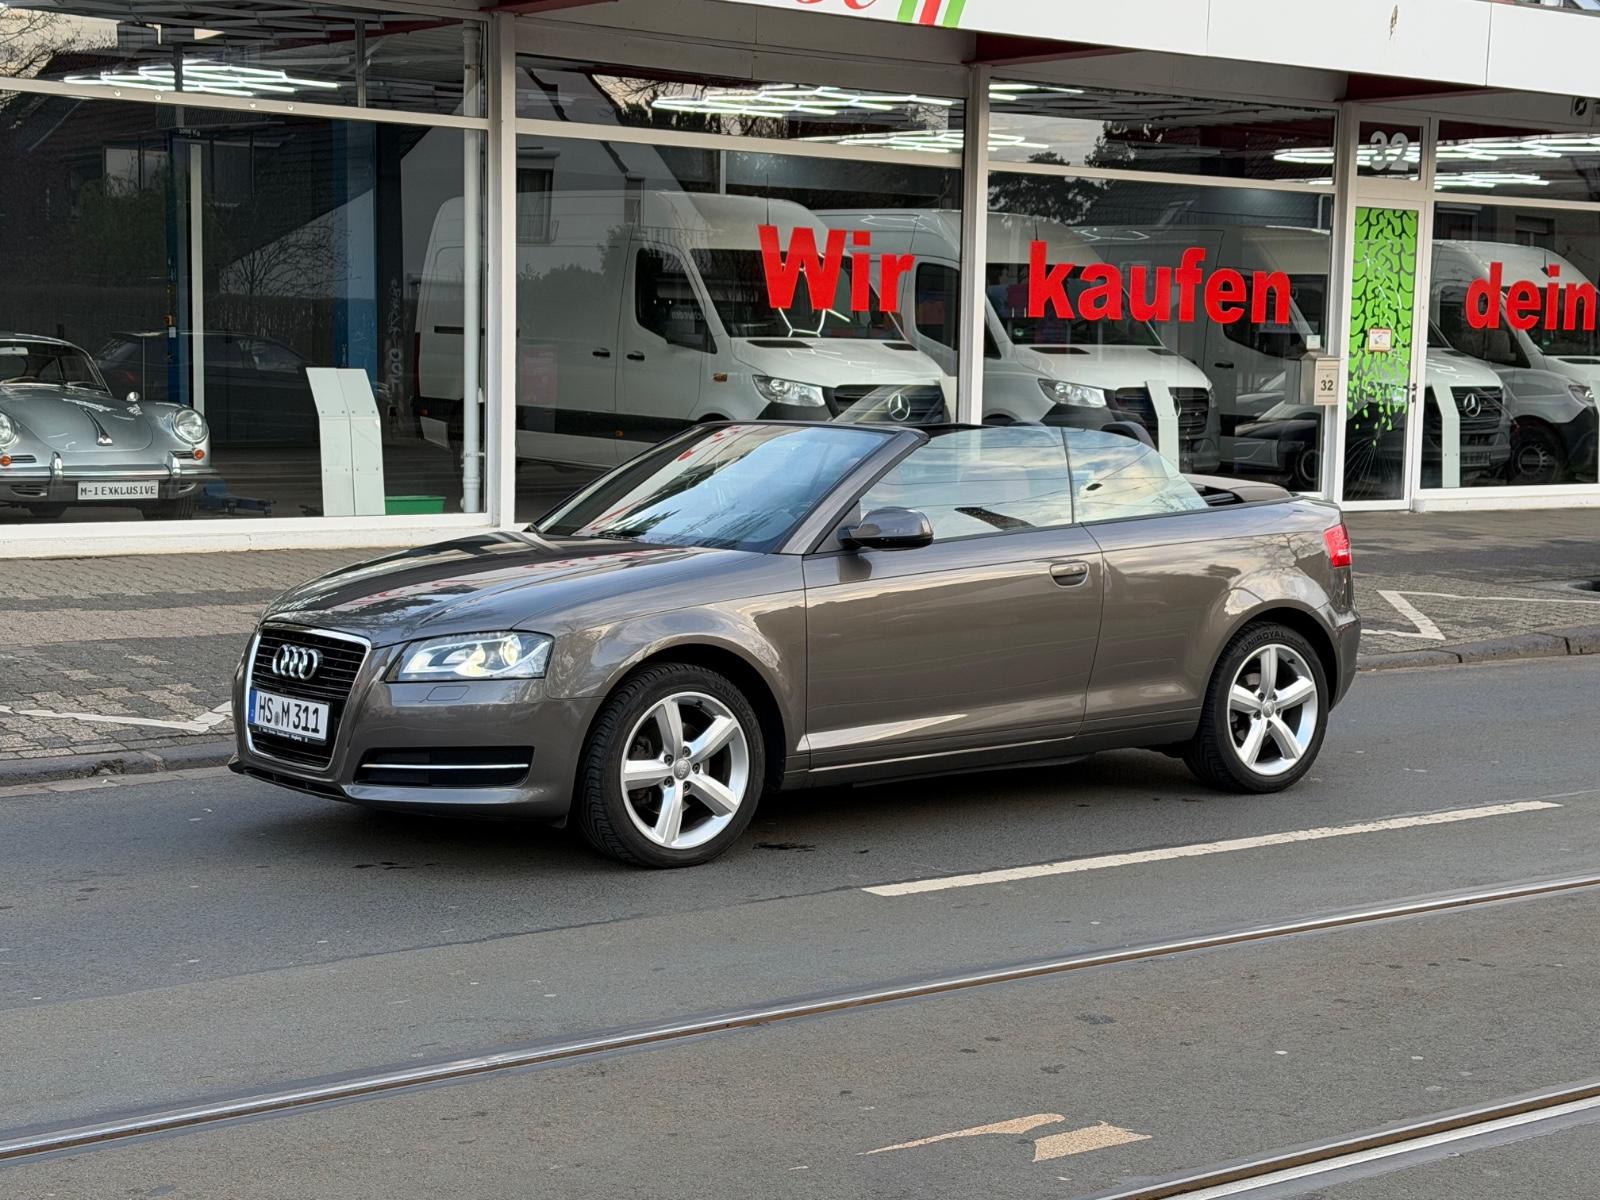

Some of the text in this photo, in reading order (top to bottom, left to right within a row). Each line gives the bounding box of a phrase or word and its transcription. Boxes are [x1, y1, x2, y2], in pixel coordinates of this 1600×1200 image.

[1370, 130, 1409, 171] 32
[758, 225, 1597, 330] Wir kaufen dein
[1320, 379, 1334, 391] 32
[258, 695, 320, 734] HS M 311
